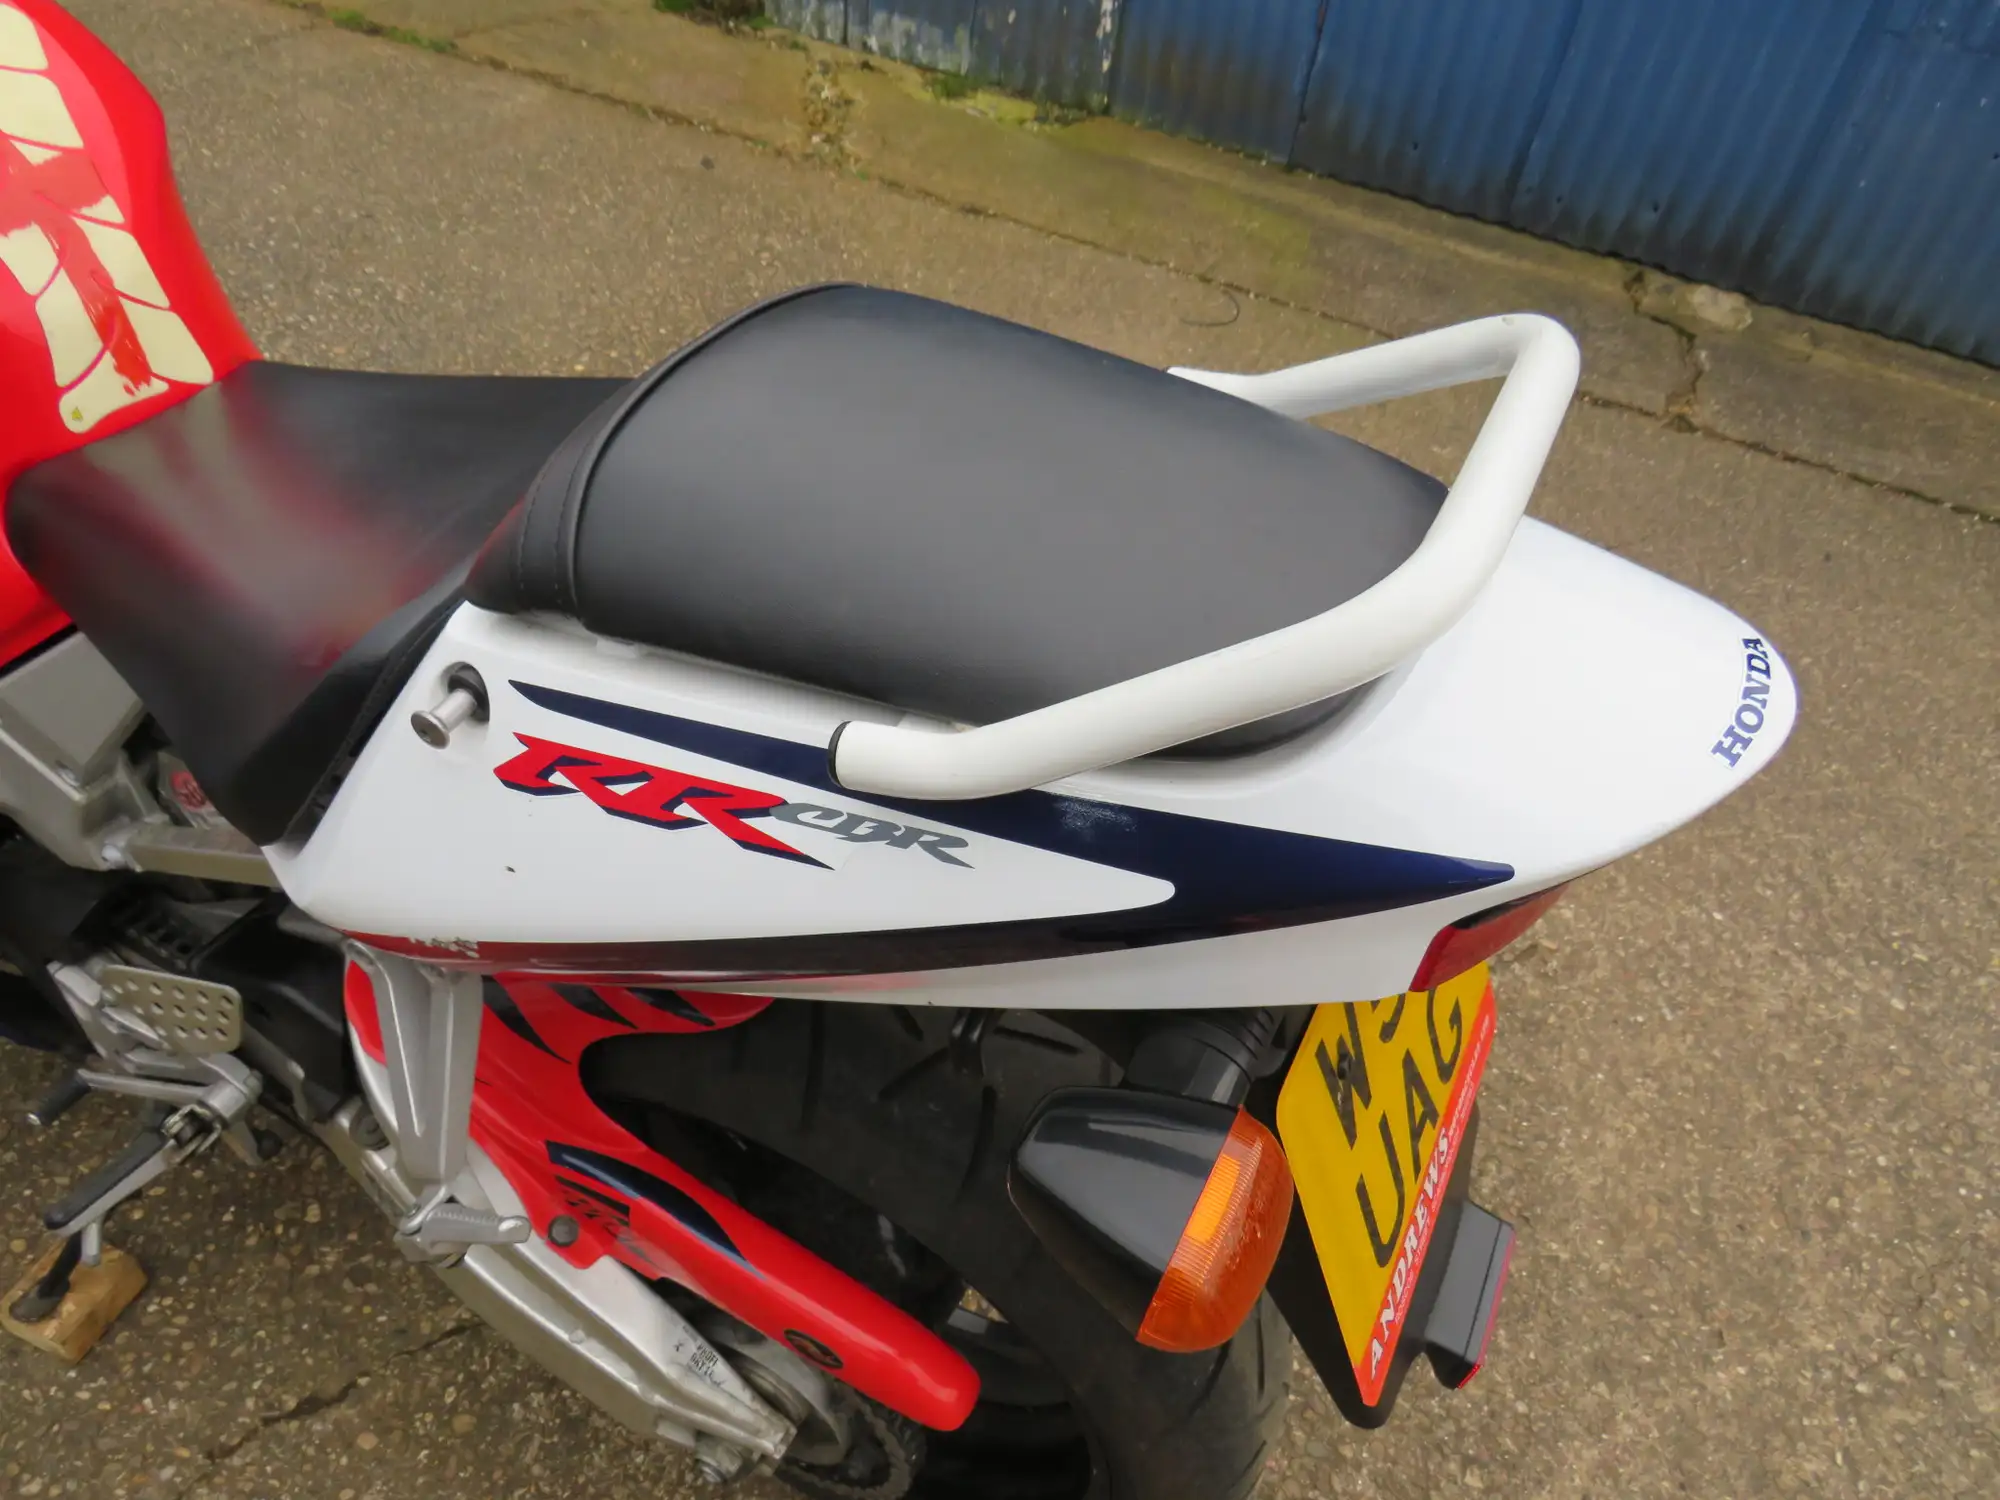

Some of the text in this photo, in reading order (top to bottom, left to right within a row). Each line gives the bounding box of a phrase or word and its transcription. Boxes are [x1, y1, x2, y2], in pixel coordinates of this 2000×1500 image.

[1710, 637, 1772, 768] HONDA
[769, 802, 975, 870] CBR
[1354, 988, 1463, 1268] UAG
[1371, 1127, 1450, 1381] ANDREWS
